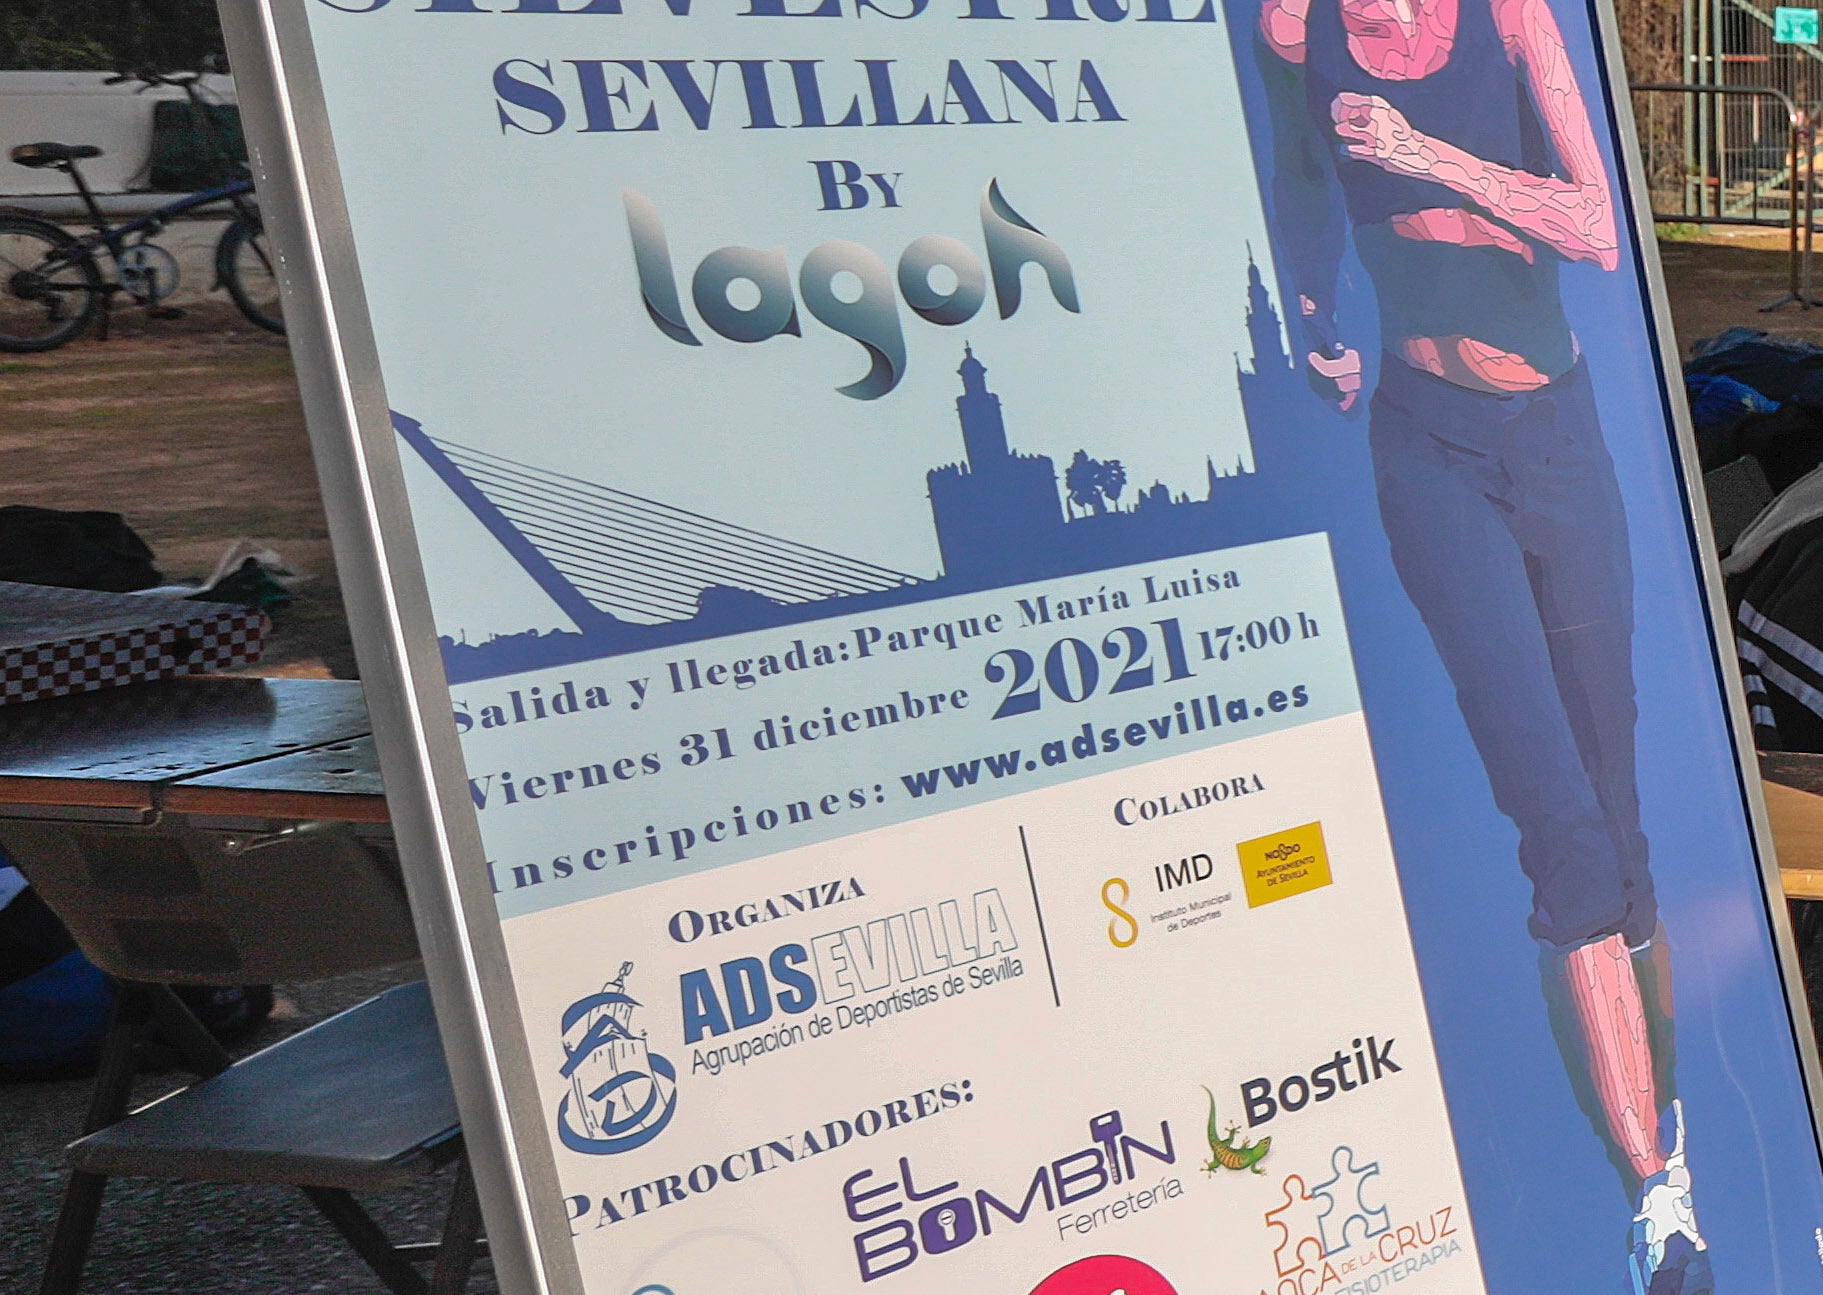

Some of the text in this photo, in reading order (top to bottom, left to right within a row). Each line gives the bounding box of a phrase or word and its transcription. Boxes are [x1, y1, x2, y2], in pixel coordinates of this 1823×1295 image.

[491, 57, 1128, 136] SEVILLANA
[620, 176, 1082, 401] lagoh
[453, 679, 612, 736] Salida
[626, 675, 651, 712] y
[1014, 585, 1131, 629] María
[1142, 565, 1241, 606] Luisa
[467, 747, 662, 811] Viernes
[680, 727, 738, 768] 31
[752, 685, 971, 753] diciembre
[983, 616, 1199, 722] 2021
[1198, 613, 1292, 664] 17:00
[487, 682, 1310, 895] Inscripciones: www.adsevilla.es
[1113, 772, 1267, 827] COLABORA
[1154, 852, 1215, 893] IMD
[1256, 855, 1316, 879] AYUNTAMIENTO
[1279, 867, 1310, 885] SEVILLA
[667, 876, 867, 945] ORGANIZA
[1150, 890, 1233, 926] Instituto Municipal
[1181, 907, 1223, 931] Deportes
[679, 886, 1019, 1046] ADSEVILLA
[691, 955, 1025, 1076] Agrupación de Deportistas de Sevilla
[1239, 1034, 1404, 1129] Bostik
[562, 1078, 976, 1238] PATROCINADORES:
[842, 1156, 960, 1225] EL
[1056, 1176, 1185, 1242] Ferretería
[1341, 1260, 1360, 1277] DE
[1360, 1251, 1379, 1269] LA
[1377, 1205, 1457, 1264] CRUZ
